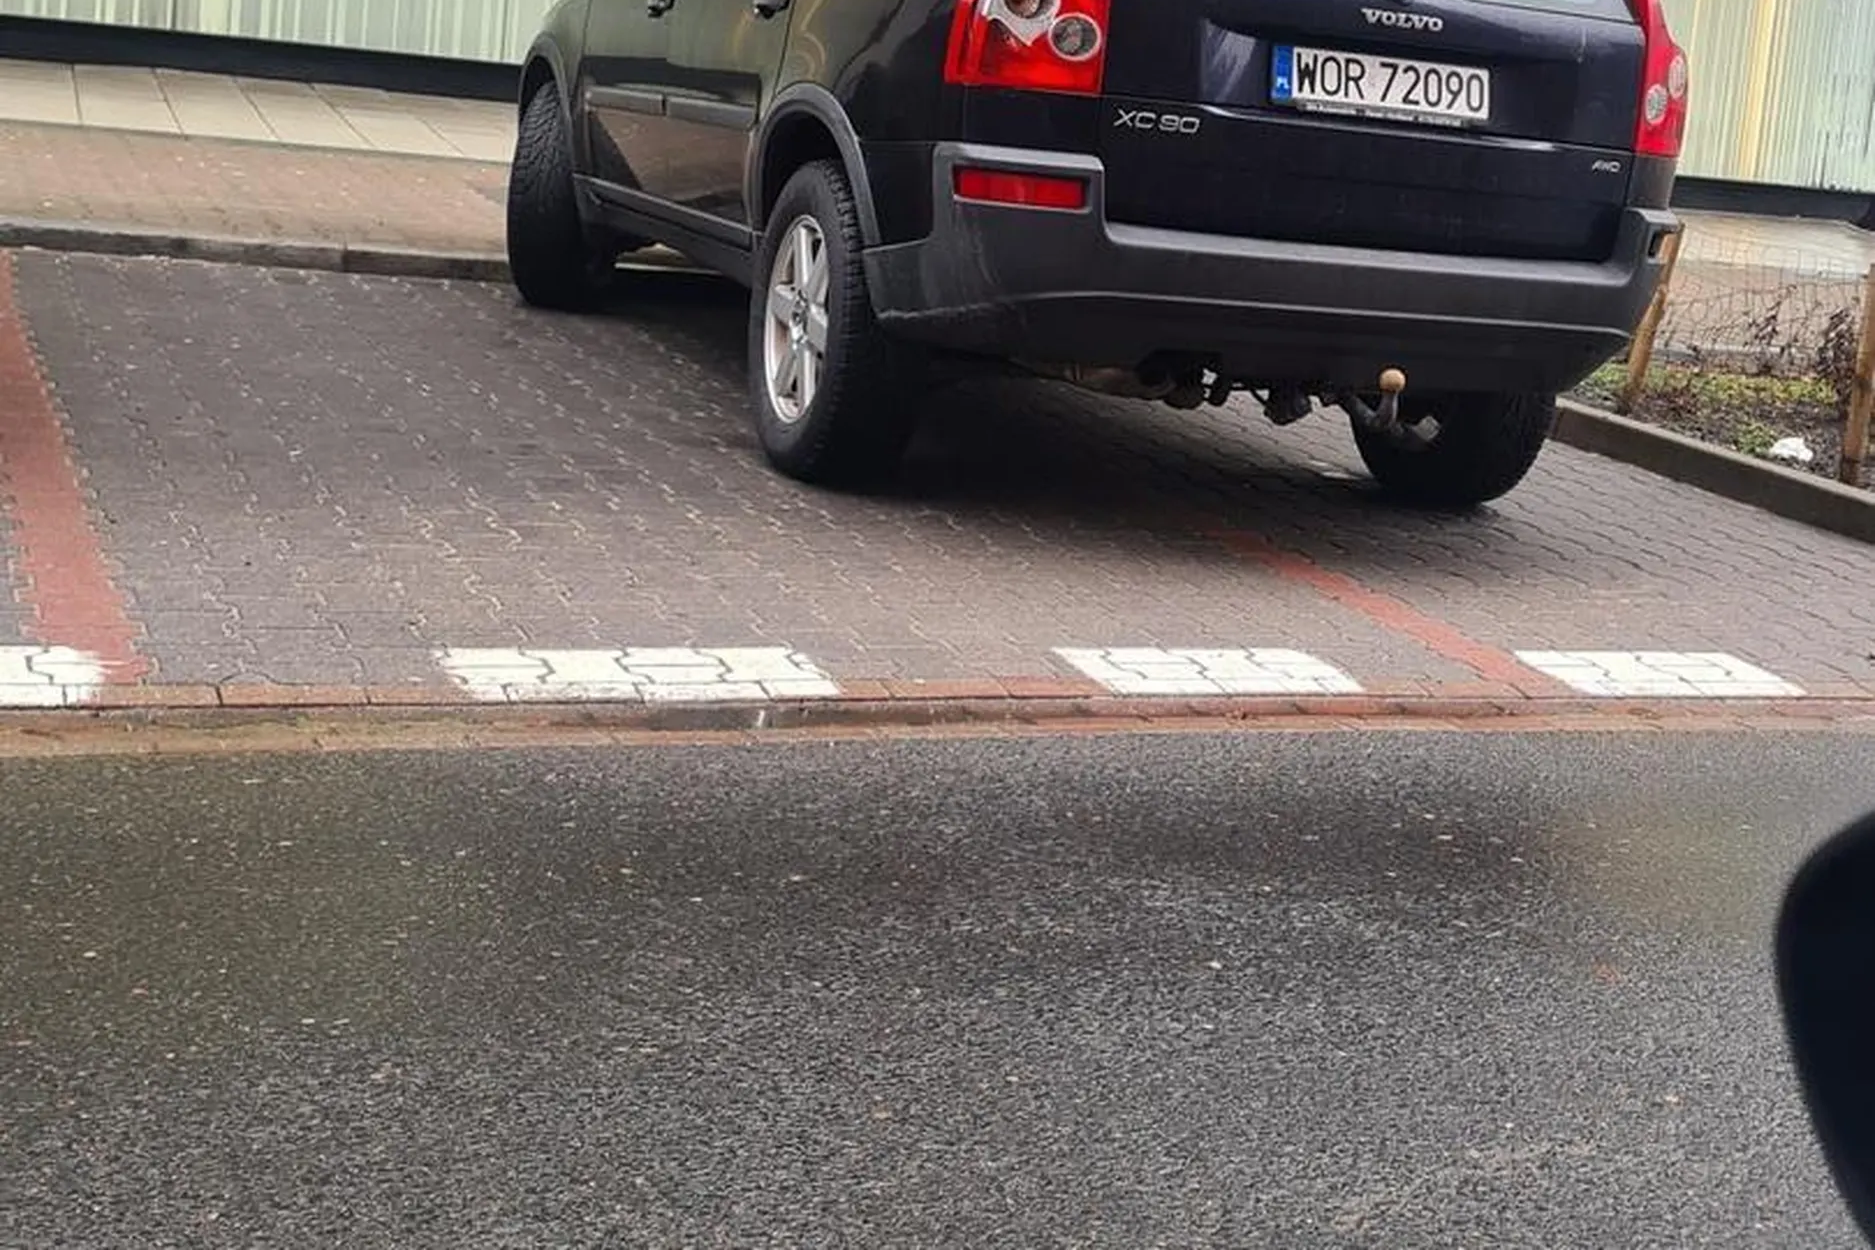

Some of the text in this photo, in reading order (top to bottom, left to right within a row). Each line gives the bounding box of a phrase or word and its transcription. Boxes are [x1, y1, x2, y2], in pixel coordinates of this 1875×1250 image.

[1361, 7, 1444, 32] VOLVO
[1296, 52, 1485, 112] WOR 72090
